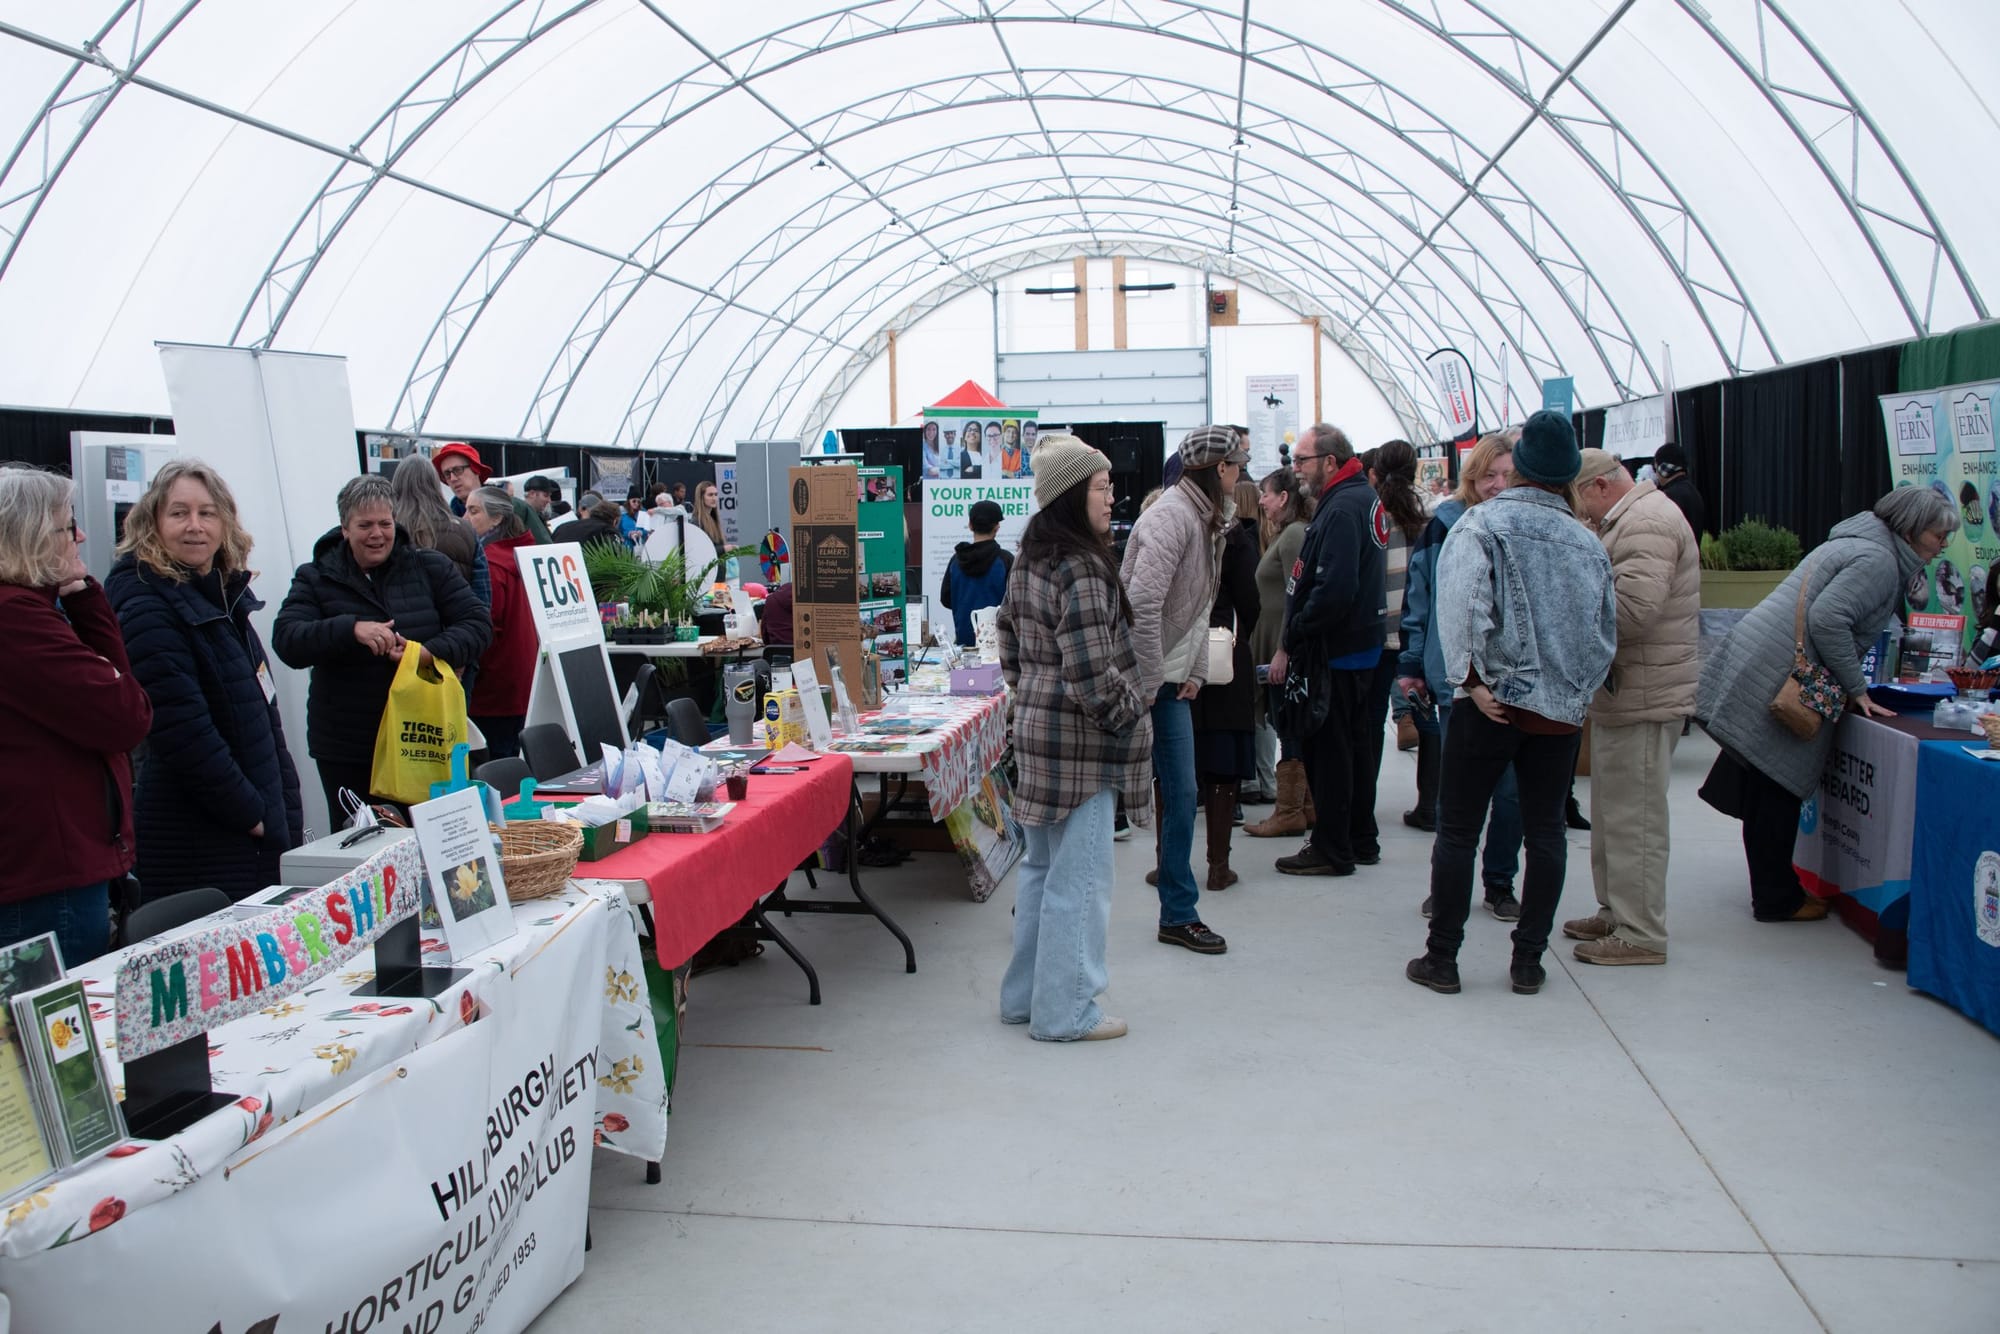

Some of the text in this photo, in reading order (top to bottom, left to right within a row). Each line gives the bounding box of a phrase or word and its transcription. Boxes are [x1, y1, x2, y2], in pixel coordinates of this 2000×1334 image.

[1898, 420, 1932, 441] ERIN
[1957, 413, 1990, 437] ERIN
[1902, 463, 1938, 475] ENHANCE
[1963, 461, 1998, 475] ENHANCE
[930, 486, 1032, 500] YOUR TALENT
[719, 497, 739, 511] ra
[931, 503, 1030, 517] OUR FURE!
[531, 553, 585, 609] ECG
[402, 721, 444, 737] TIGRE
[409, 749, 427, 758] LES
[428, 750, 446, 761] BAS
[150, 864, 398, 1029] MEMBERSHIP
[512, 1231, 537, 1270] 1953
